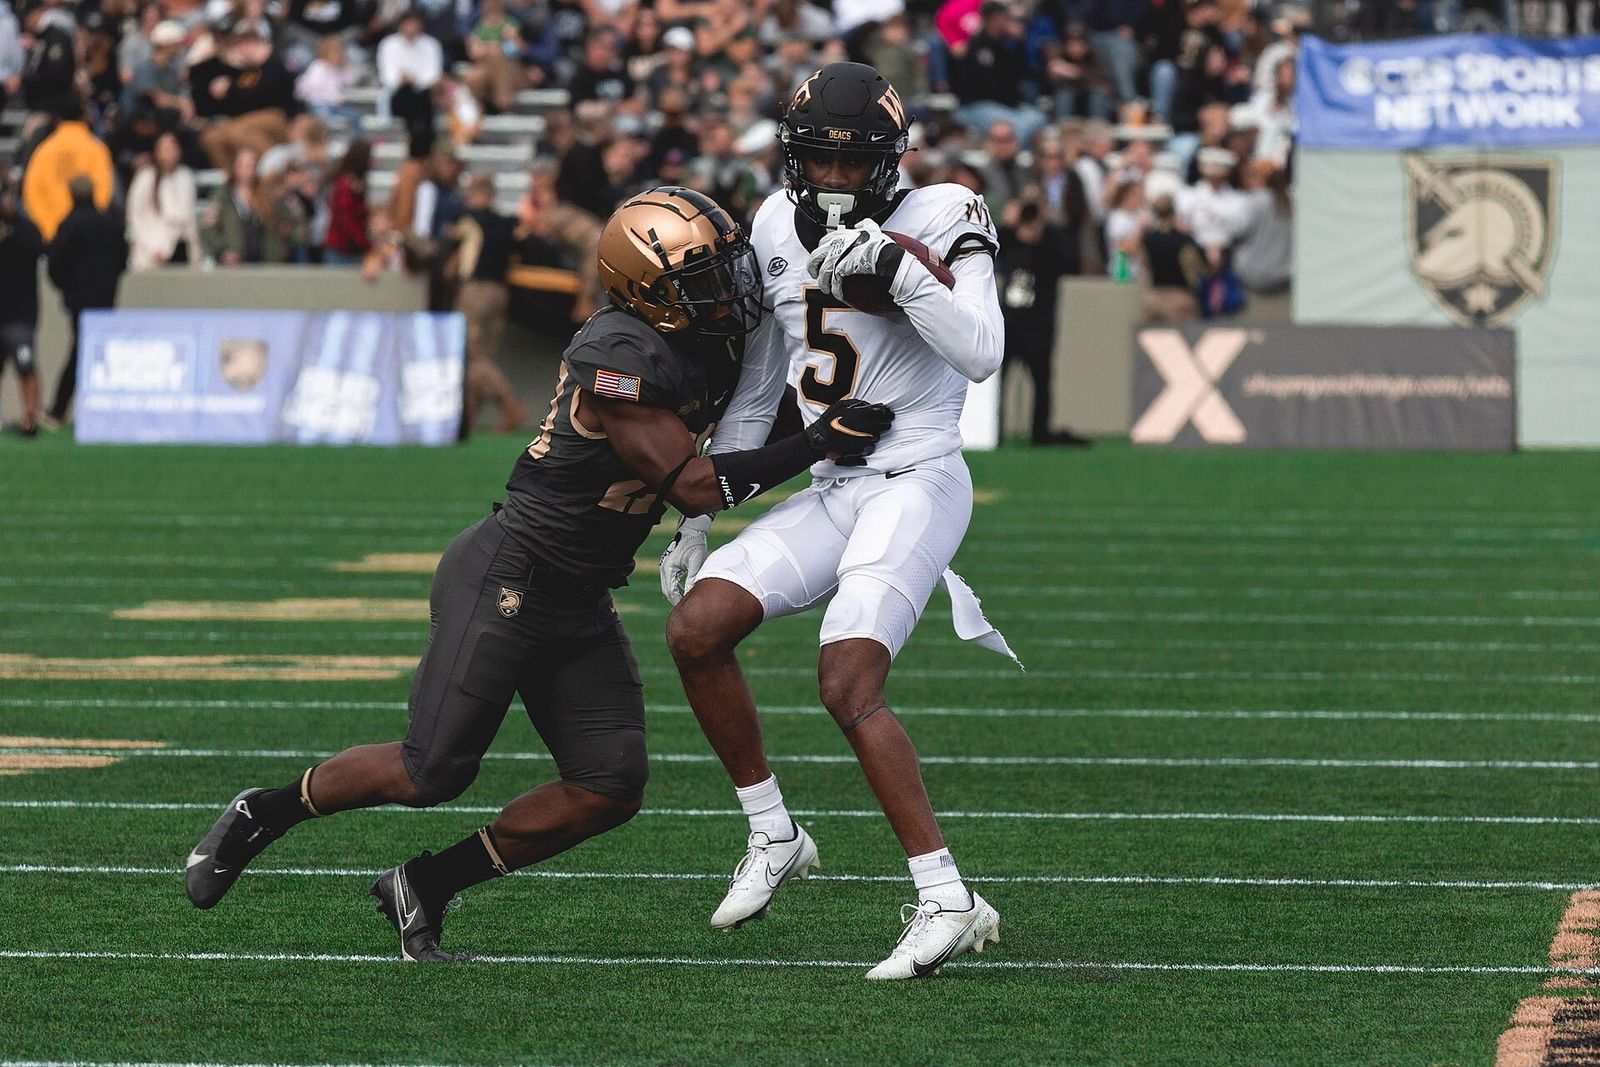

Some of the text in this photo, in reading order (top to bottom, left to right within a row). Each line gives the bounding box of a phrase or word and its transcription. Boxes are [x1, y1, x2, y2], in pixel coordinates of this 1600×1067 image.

[1374, 92, 1583, 132] NETWORK
[829, 129, 852, 141] DEACS
[798, 284, 861, 411] 5
[1131, 327, 1248, 444] X
[718, 476, 734, 502] NIKE
